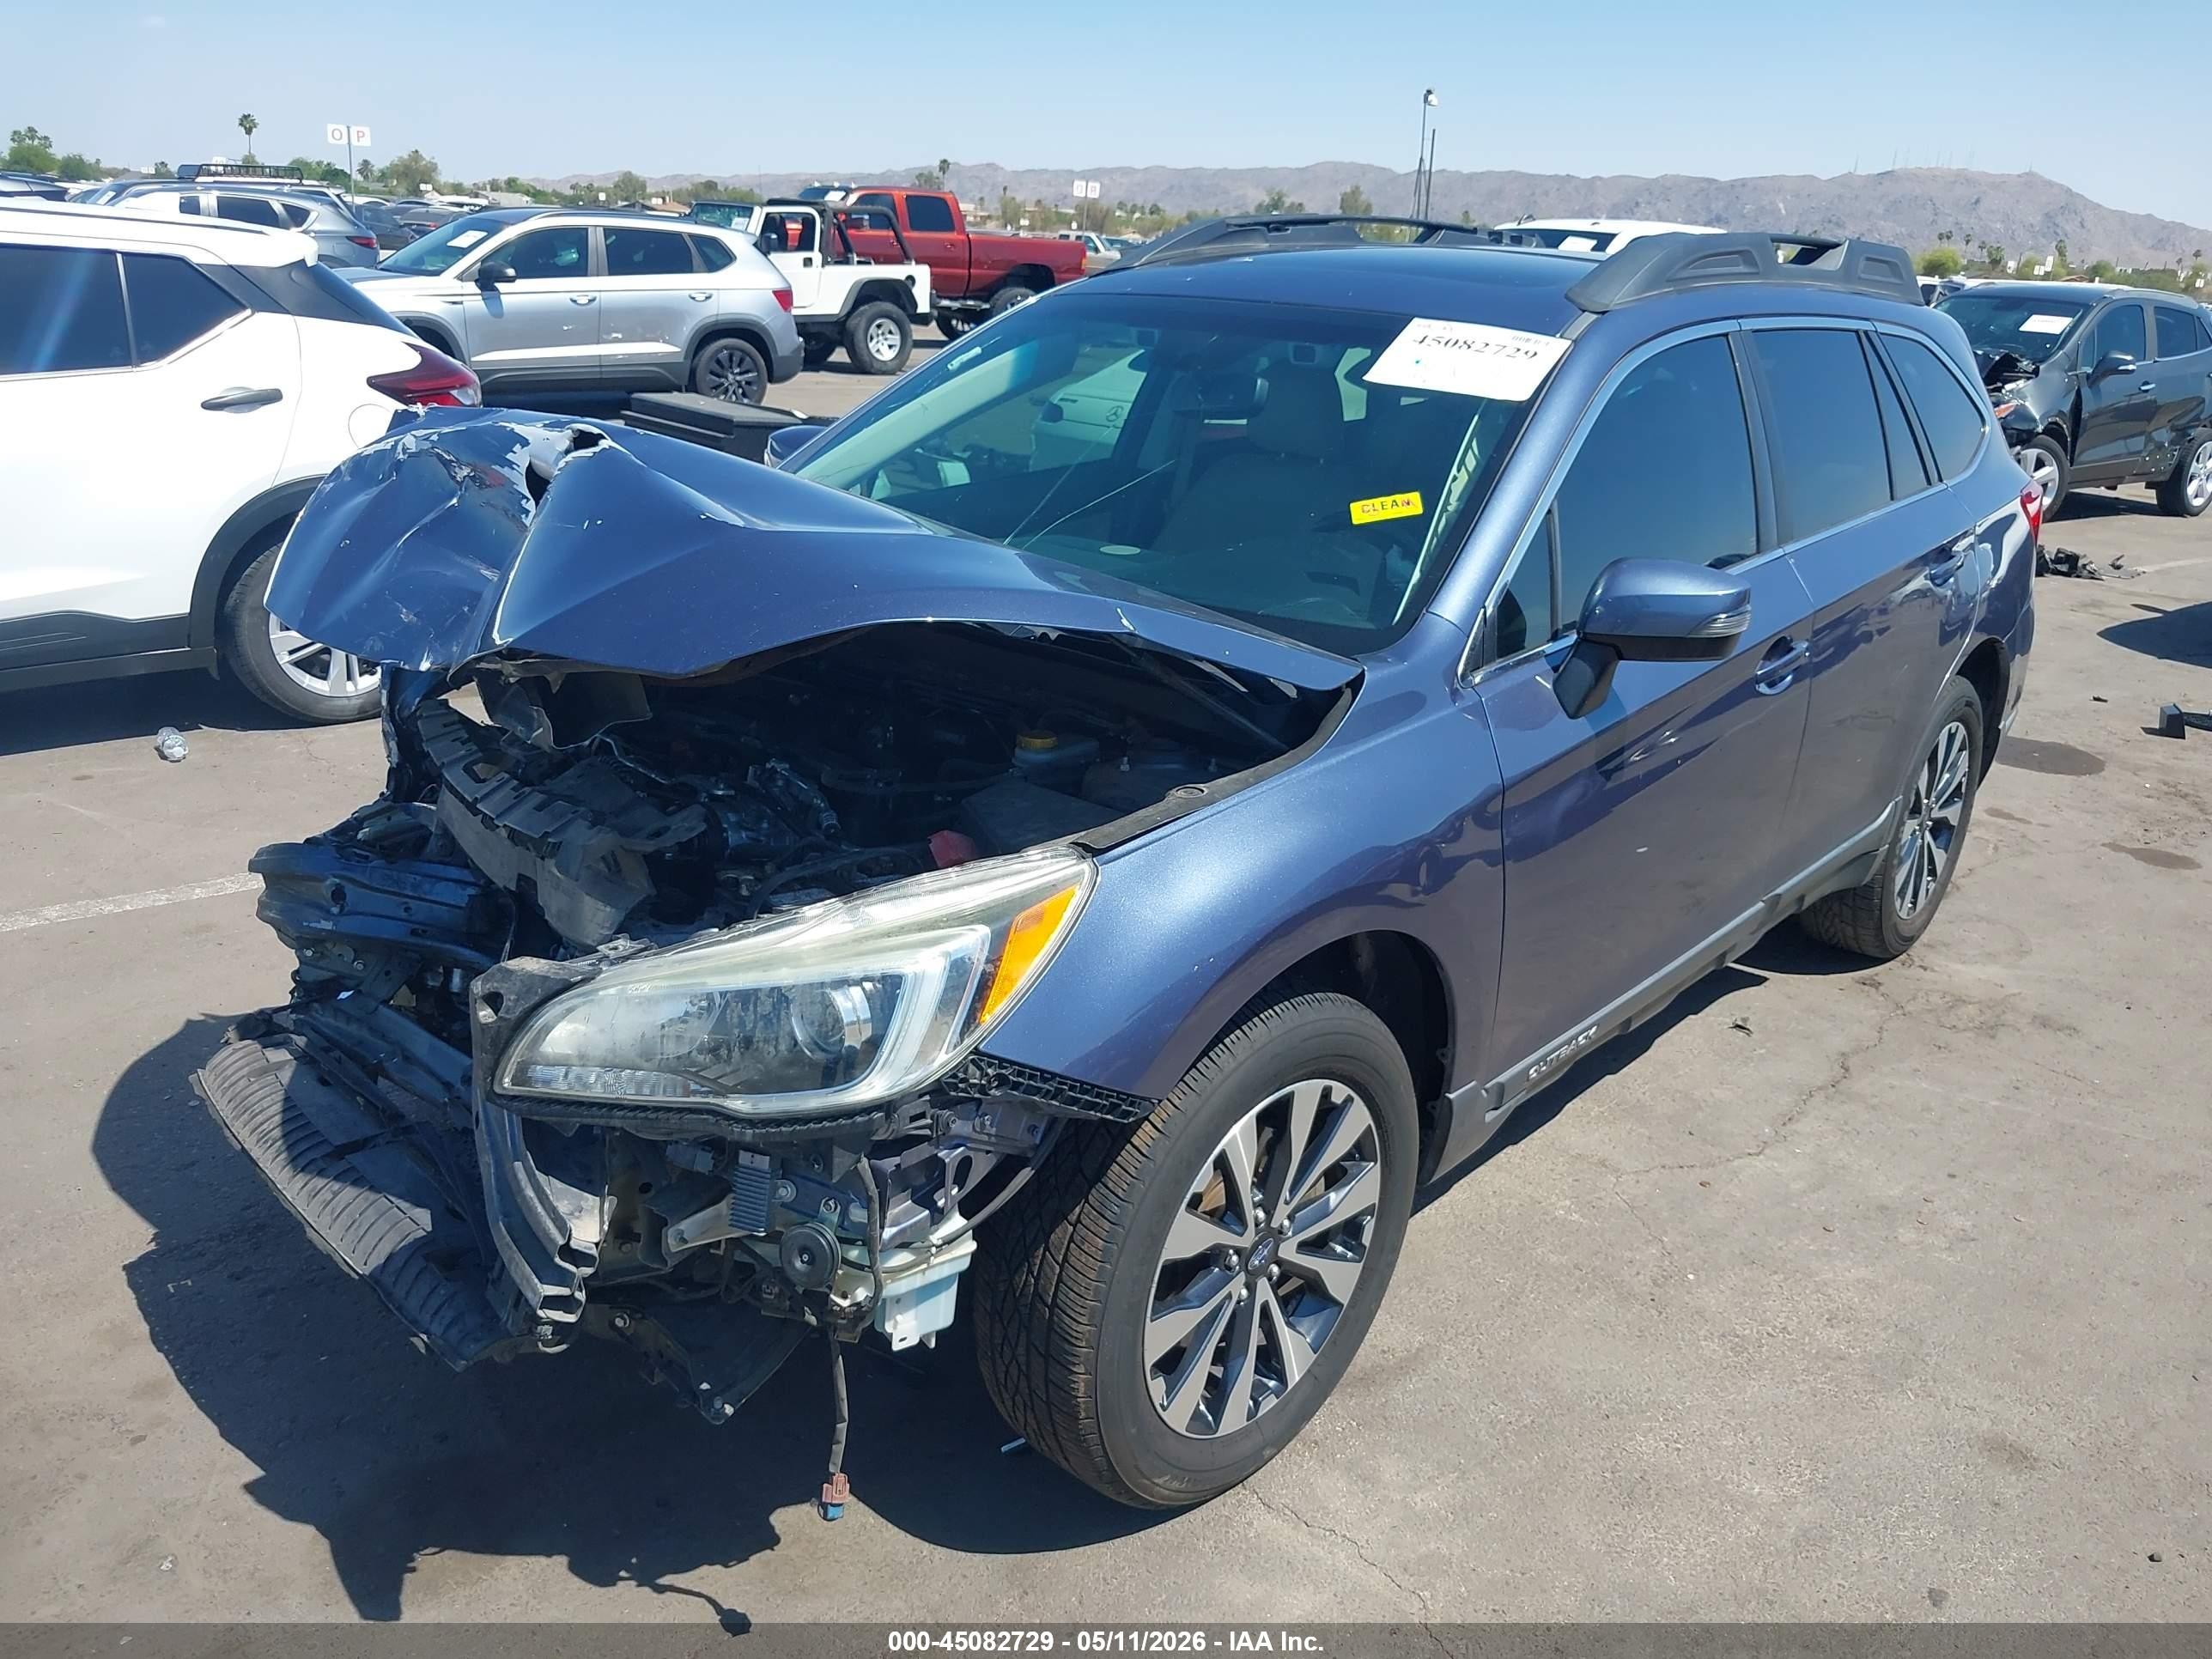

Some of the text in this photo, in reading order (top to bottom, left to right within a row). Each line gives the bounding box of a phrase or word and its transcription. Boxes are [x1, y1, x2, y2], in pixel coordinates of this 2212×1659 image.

[331, 128, 343, 141] O
[356, 130, 366, 143] P
[1413, 333, 1540, 360] 45082729
[1360, 497, 1414, 514] CLEAN
